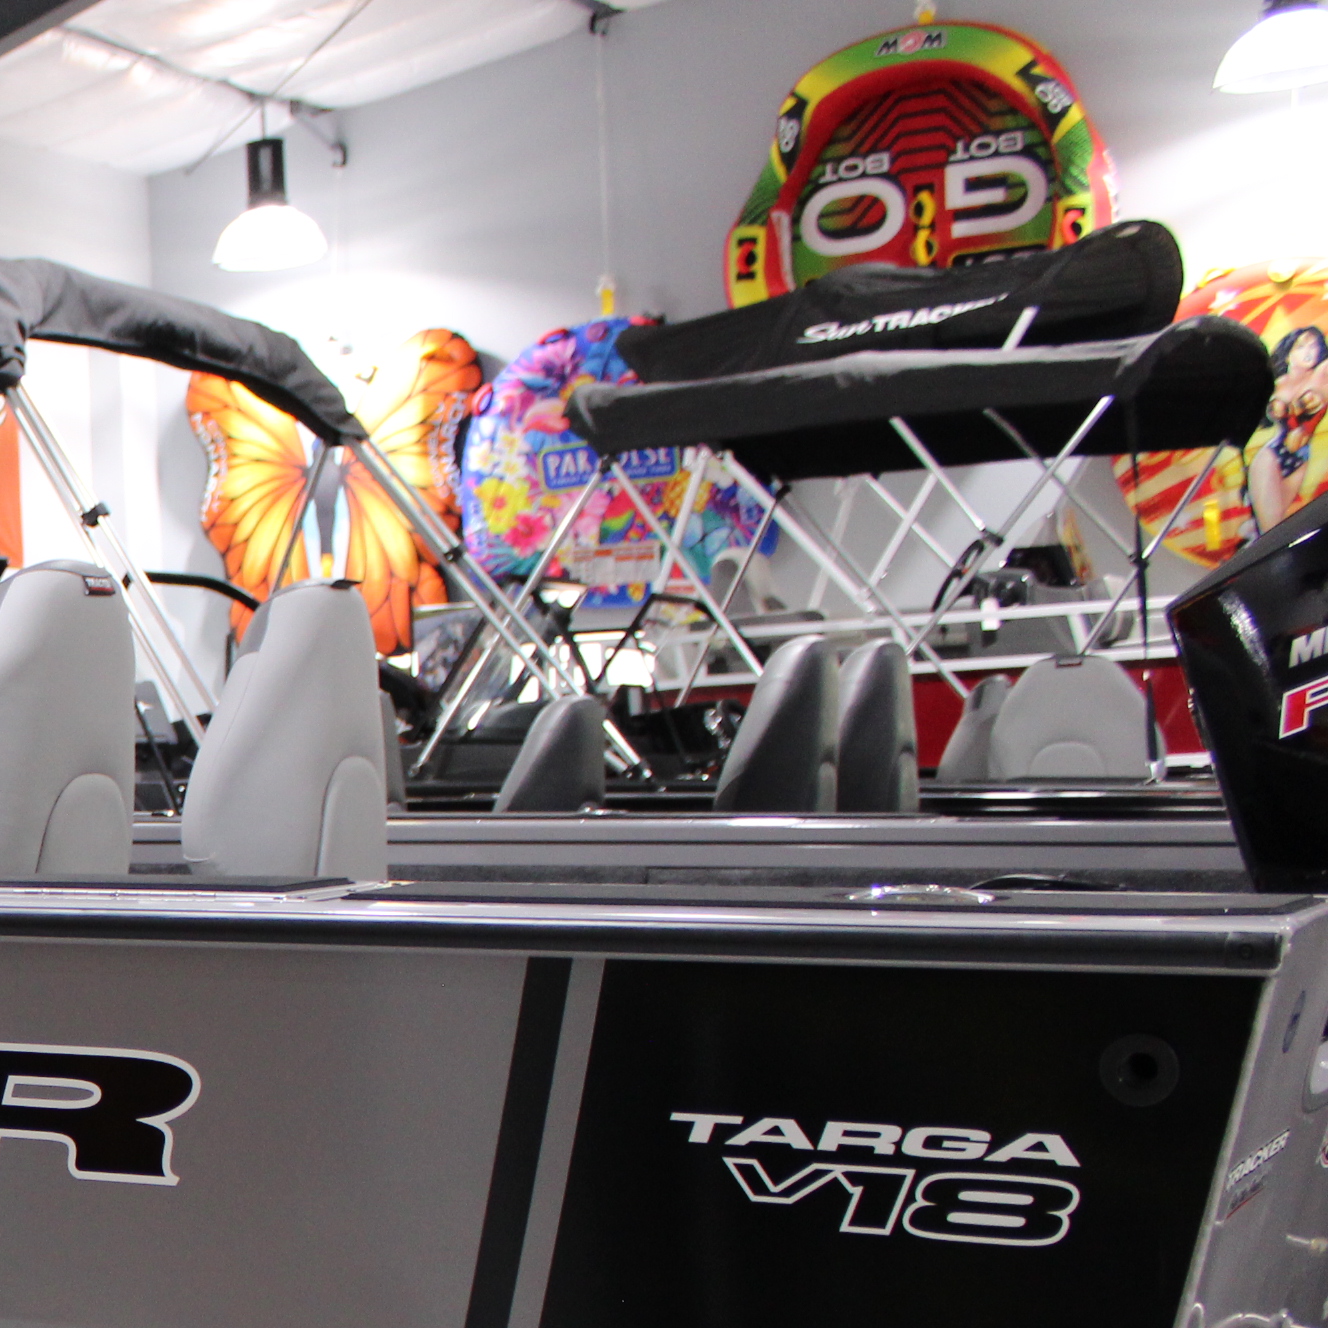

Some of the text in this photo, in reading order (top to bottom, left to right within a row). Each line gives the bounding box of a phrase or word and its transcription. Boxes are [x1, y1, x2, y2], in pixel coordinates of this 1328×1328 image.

[818, 130, 1025, 185] BOT BOT
[670, 1112, 1082, 1168] TARGA
[723, 1156, 1081, 1247] V18
